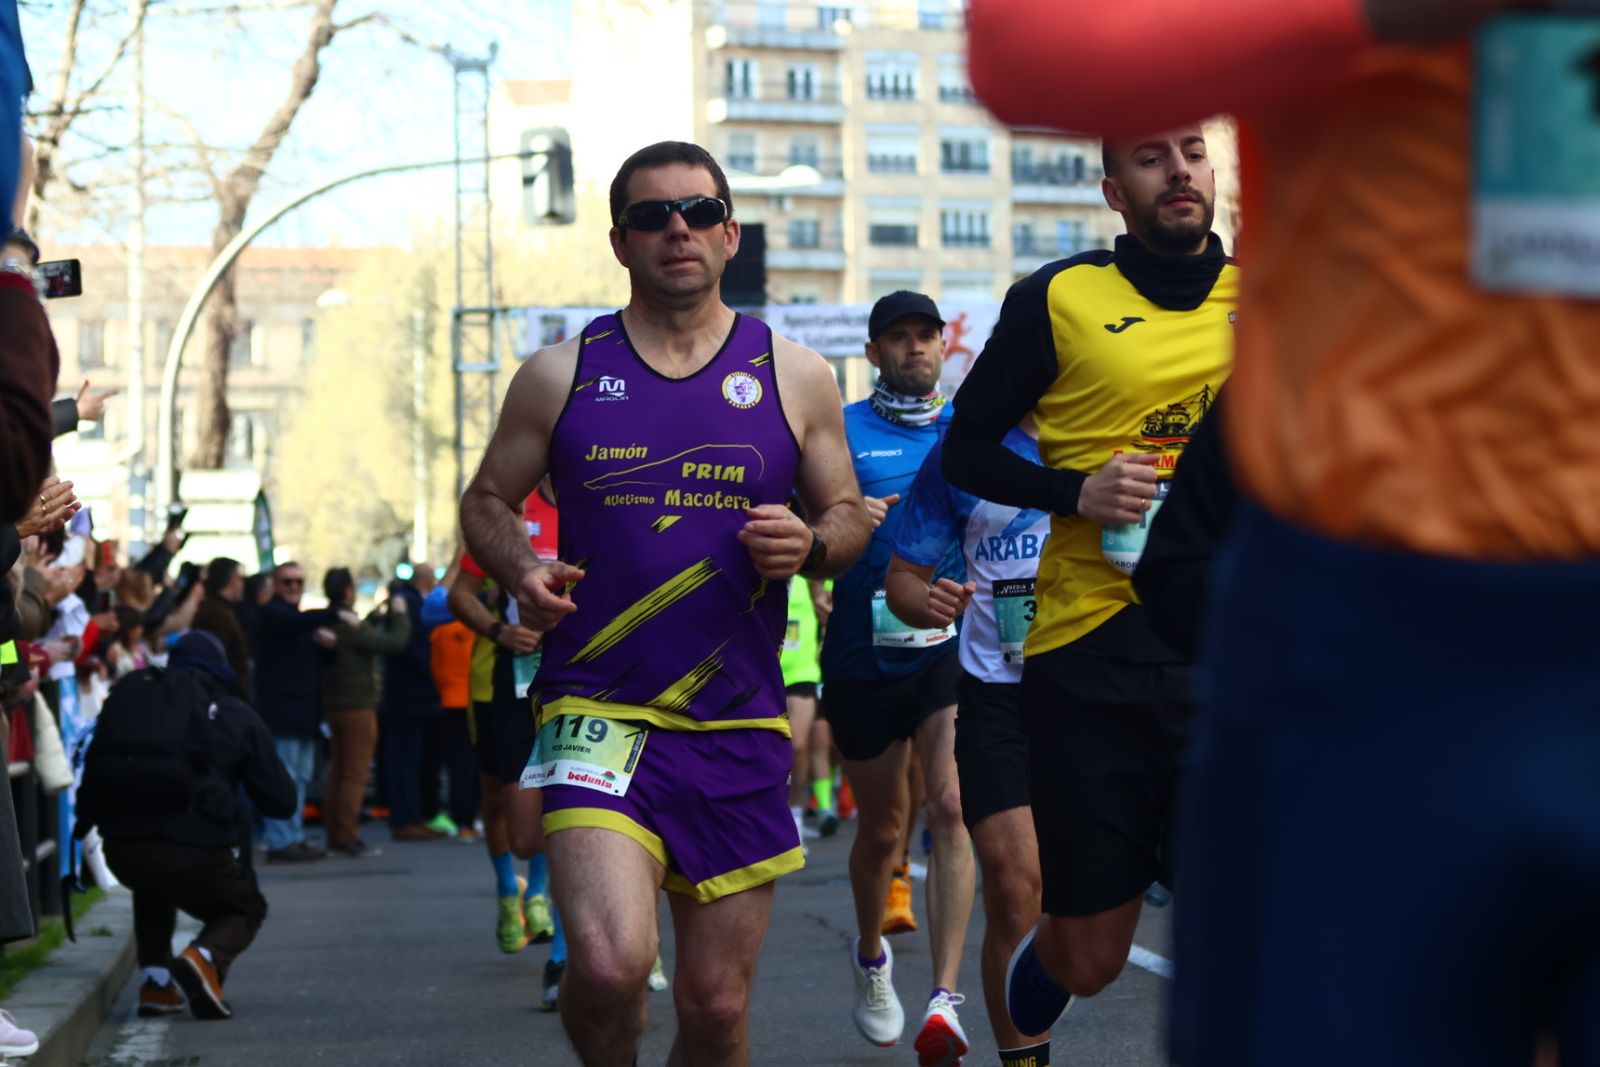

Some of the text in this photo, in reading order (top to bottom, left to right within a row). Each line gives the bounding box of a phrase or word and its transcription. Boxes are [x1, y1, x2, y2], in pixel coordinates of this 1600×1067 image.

[585, 444, 648, 461] Jamón
[871, 449, 903, 457] BROOKS
[681, 462, 745, 483] PRIM
[604, 489, 751, 510] Atletismo Macotera
[554, 715, 608, 743] 119
[563, 743, 592, 755] JAVIER
[567, 771, 612, 788] bedunia
